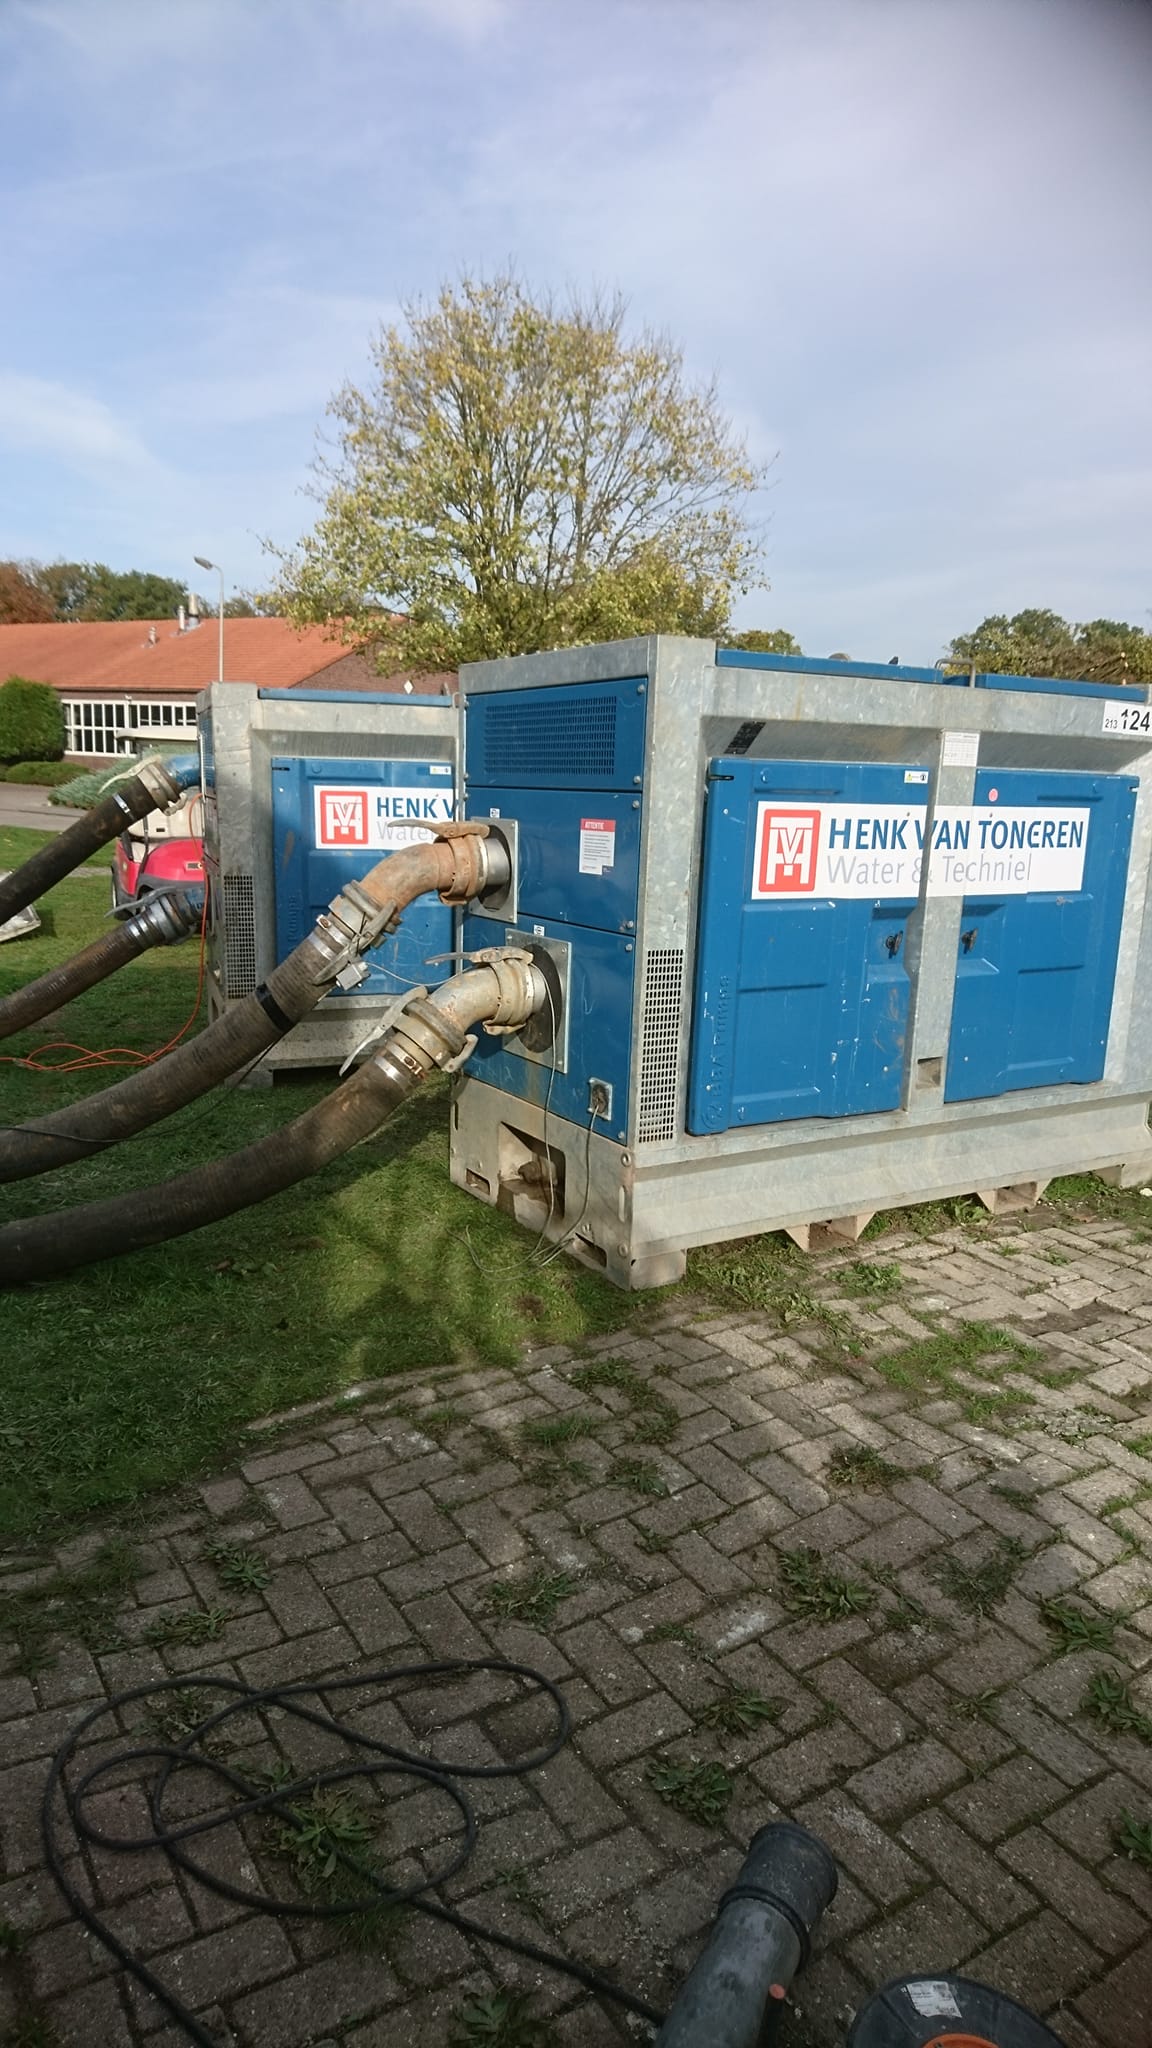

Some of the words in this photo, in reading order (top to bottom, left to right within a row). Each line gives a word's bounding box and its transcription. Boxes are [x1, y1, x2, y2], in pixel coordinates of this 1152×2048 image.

[1120, 708, 1151, 732] 124
[376, 796, 439, 819] HENK
[828, 817, 909, 850] HENK
[914, 819, 971, 850] VAN
[826, 855, 905, 884] Water
